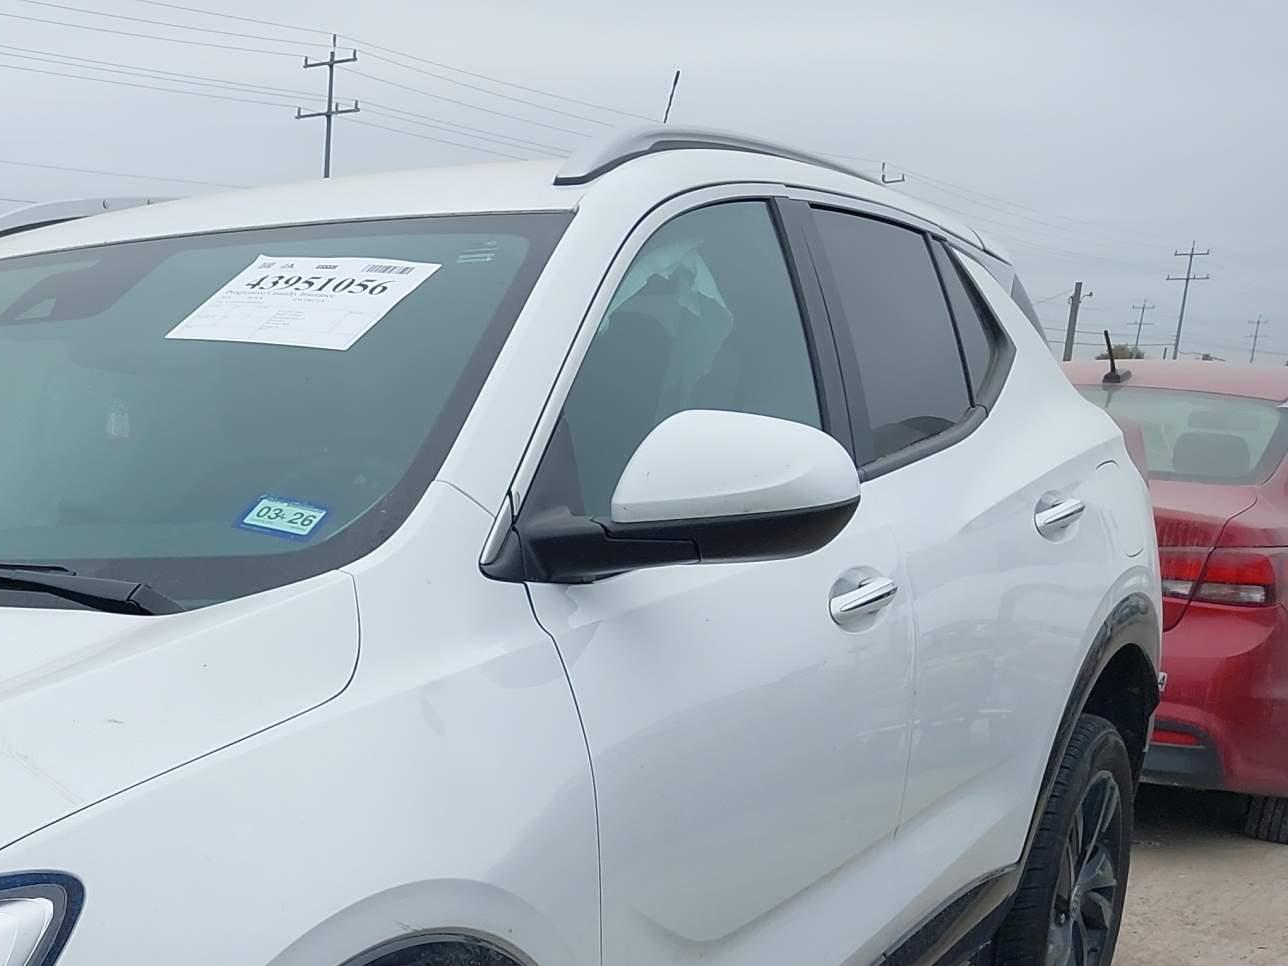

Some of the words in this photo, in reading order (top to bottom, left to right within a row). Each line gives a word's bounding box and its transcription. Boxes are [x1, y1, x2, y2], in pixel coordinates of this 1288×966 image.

[245, 274, 397, 296] 43951056
[255, 505, 284, 520] 03
[286, 511, 318, 527] 26
